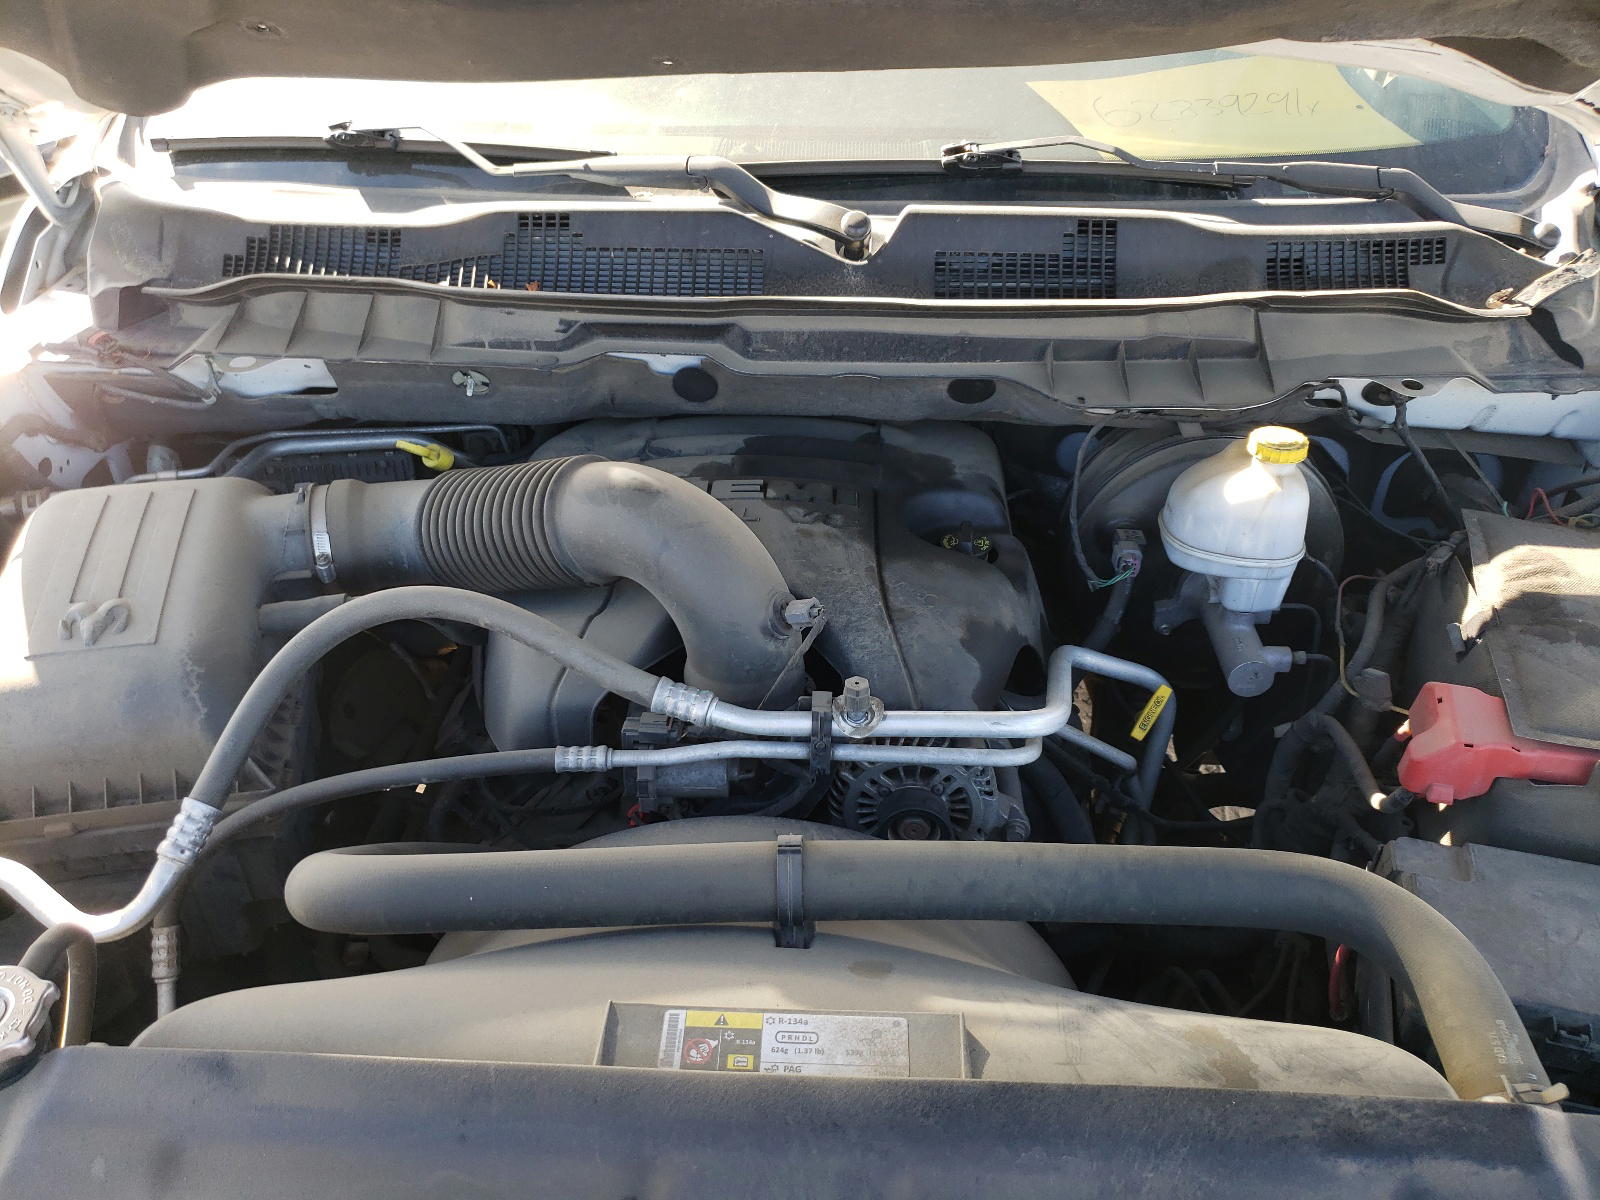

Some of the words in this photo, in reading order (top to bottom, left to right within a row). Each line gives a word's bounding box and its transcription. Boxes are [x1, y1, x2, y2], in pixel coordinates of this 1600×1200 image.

[778, 1016, 809, 1026] R-134a
[770, 1046, 789, 1055] 624g
[794, 1047, 813, 1056] (1.37
[783, 1065, 802, 1073] PAG
